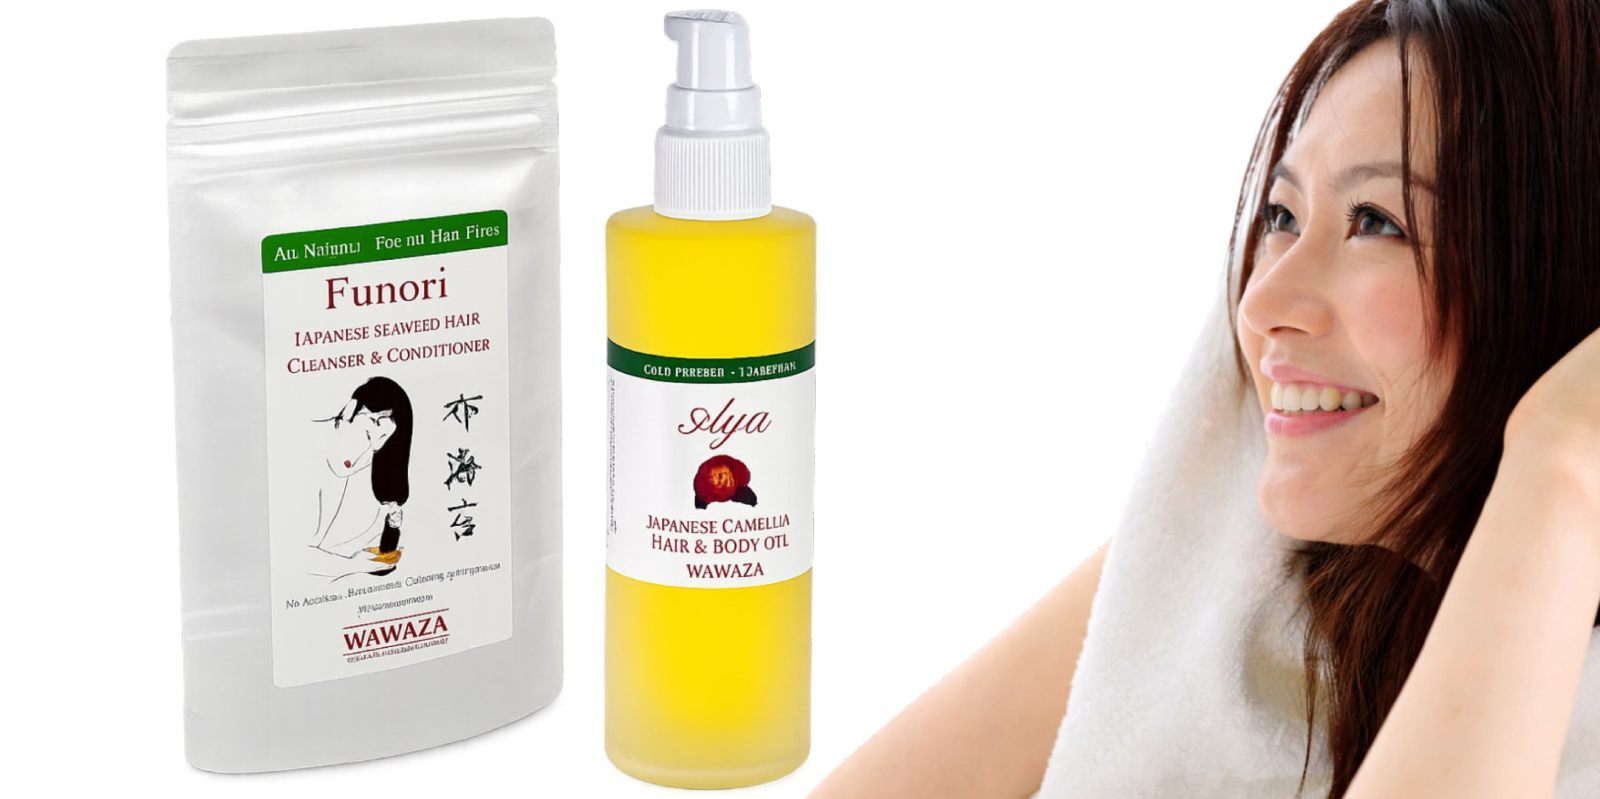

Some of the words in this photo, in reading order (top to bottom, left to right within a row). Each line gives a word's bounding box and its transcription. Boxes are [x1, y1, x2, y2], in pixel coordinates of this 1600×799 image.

[325, 266, 448, 310] Funori
[374, 318, 440, 338] SEAWEED
[444, 312, 481, 329] HAIR
[370, 350, 383, 365] &
[646, 515, 718, 534] JAPANESE
[722, 514, 790, 533] CAMELLIA
[652, 534, 689, 553] HAIR
[694, 540, 707, 554] &
[713, 538, 760, 554] BODY
[686, 562, 764, 578] WAWAZA
[343, 615, 448, 650] WAWAZA
